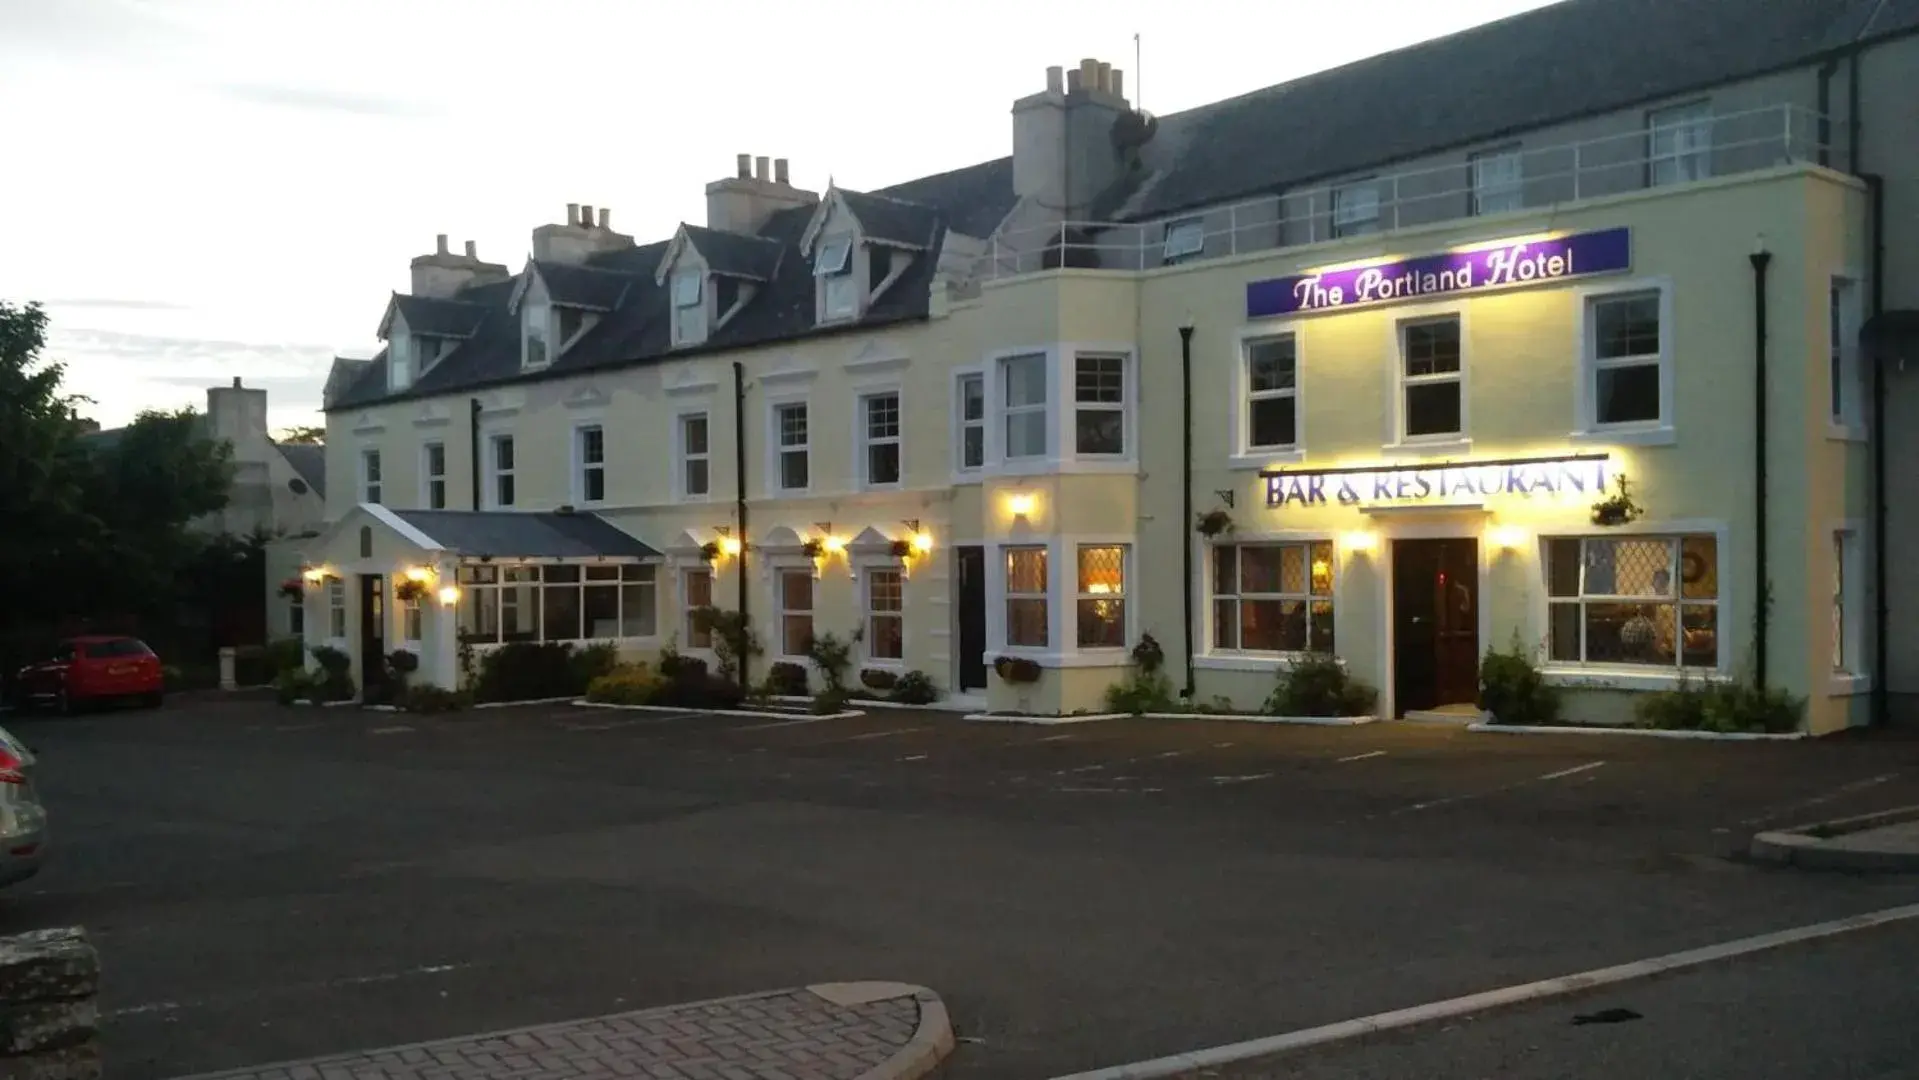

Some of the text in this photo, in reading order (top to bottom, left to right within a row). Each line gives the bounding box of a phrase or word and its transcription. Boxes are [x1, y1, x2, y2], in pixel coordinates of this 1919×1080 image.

[1293, 245, 1573, 309] The Portland Hotel
[1265, 461, 1607, 508] BAR & RESTAURANT
